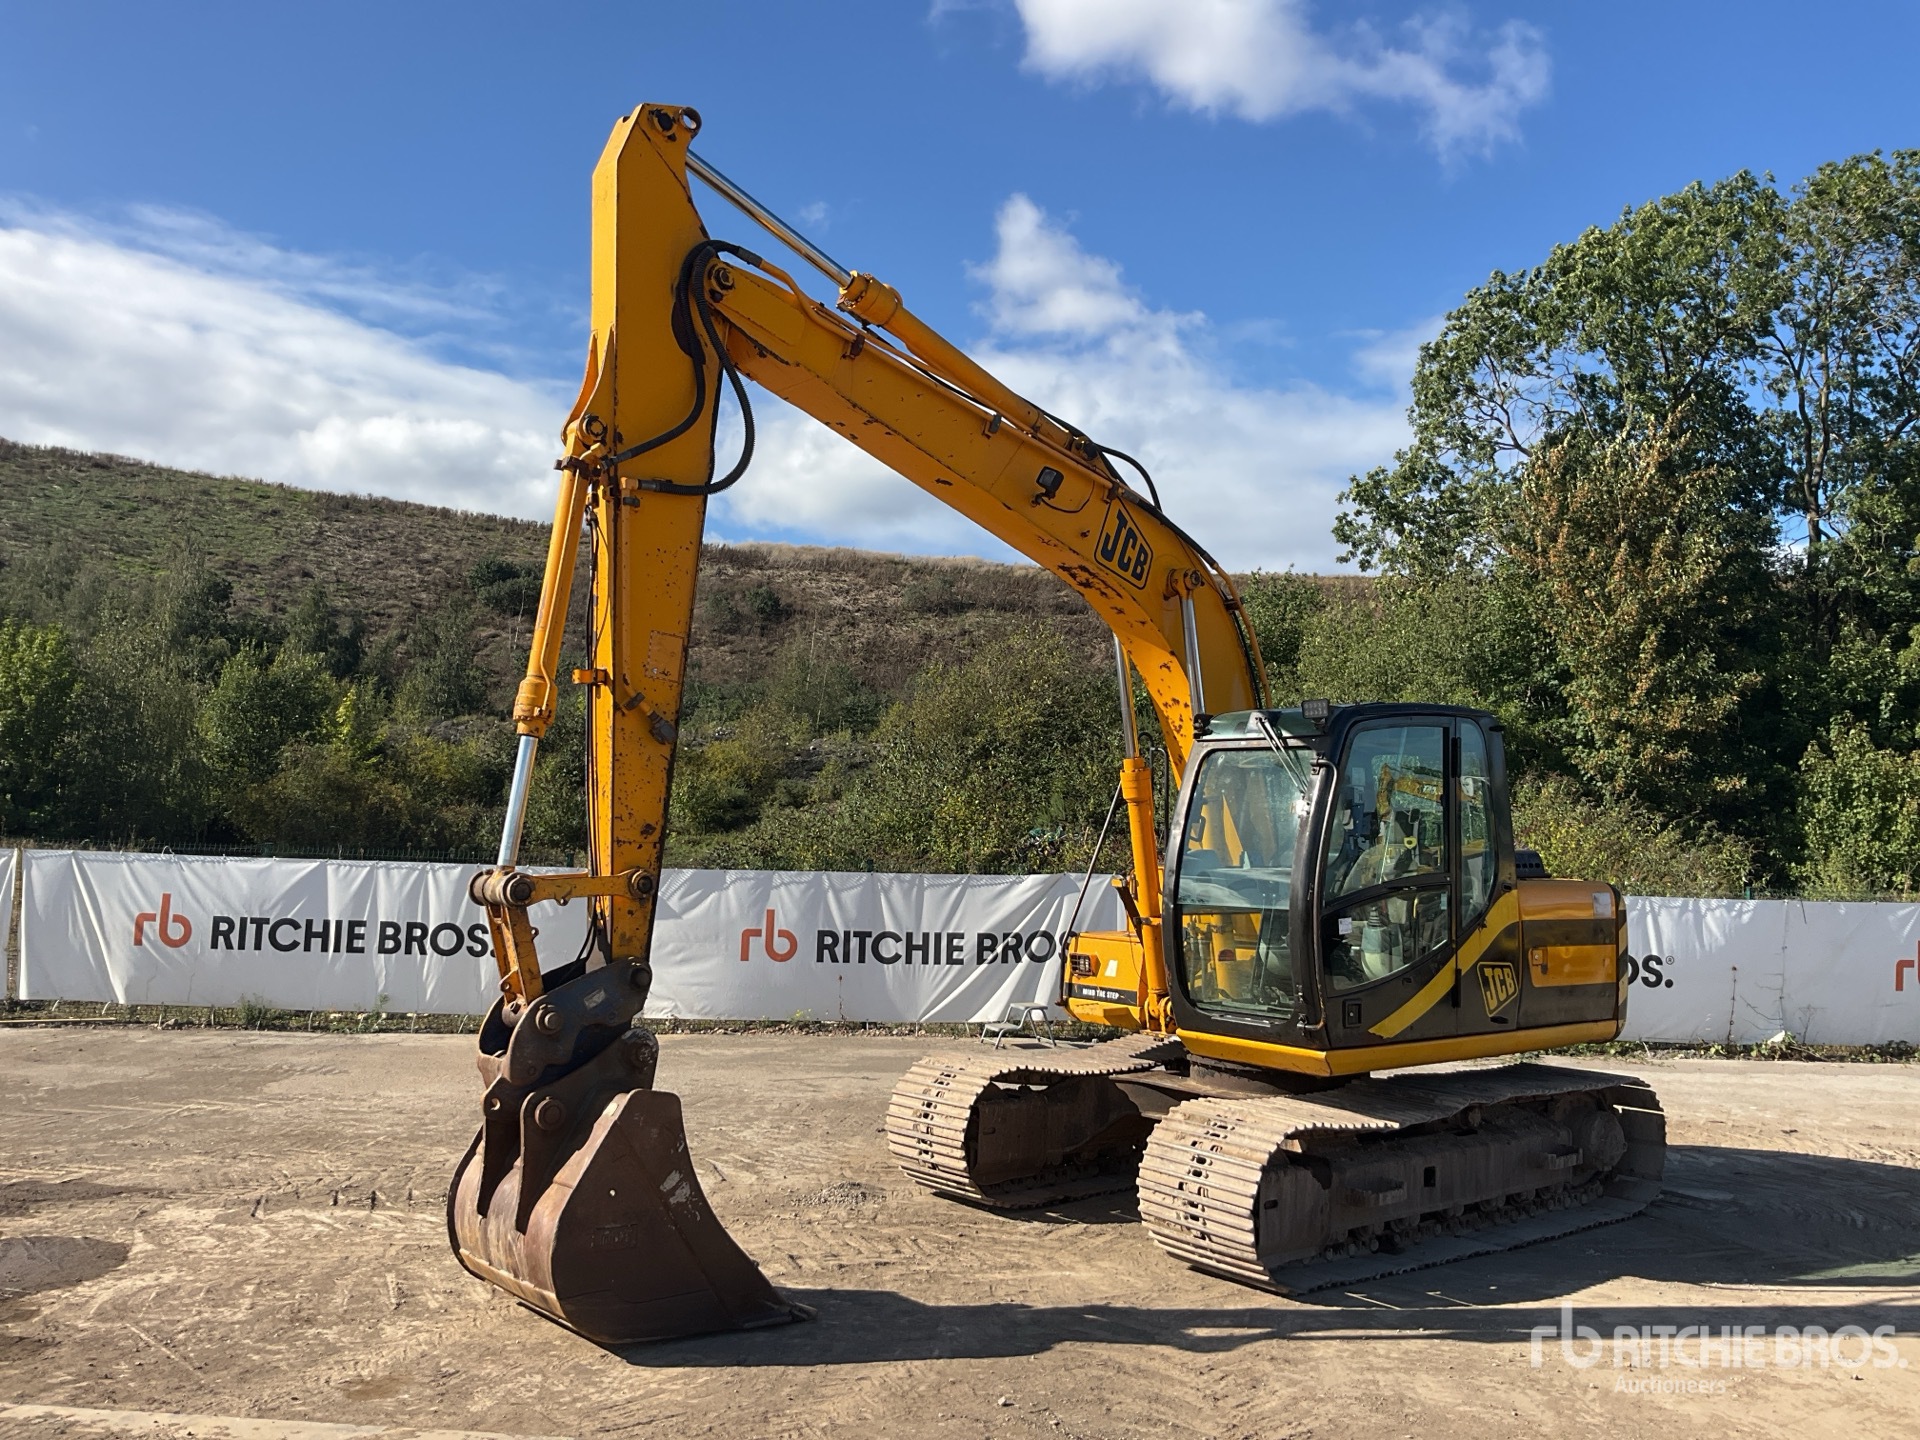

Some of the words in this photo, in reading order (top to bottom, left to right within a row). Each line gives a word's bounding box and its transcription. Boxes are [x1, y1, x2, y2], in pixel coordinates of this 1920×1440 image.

[1101, 509, 1149, 581] JCB
[133, 892, 193, 948] rb
[210, 915, 367, 953] RITCHIE
[740, 909, 798, 963] rb
[816, 930, 965, 965] RITCHIE
[1483, 966, 1516, 1010] JCB
[1895, 940, 1920, 991] r
[1106, 991, 1120, 999] STEP
